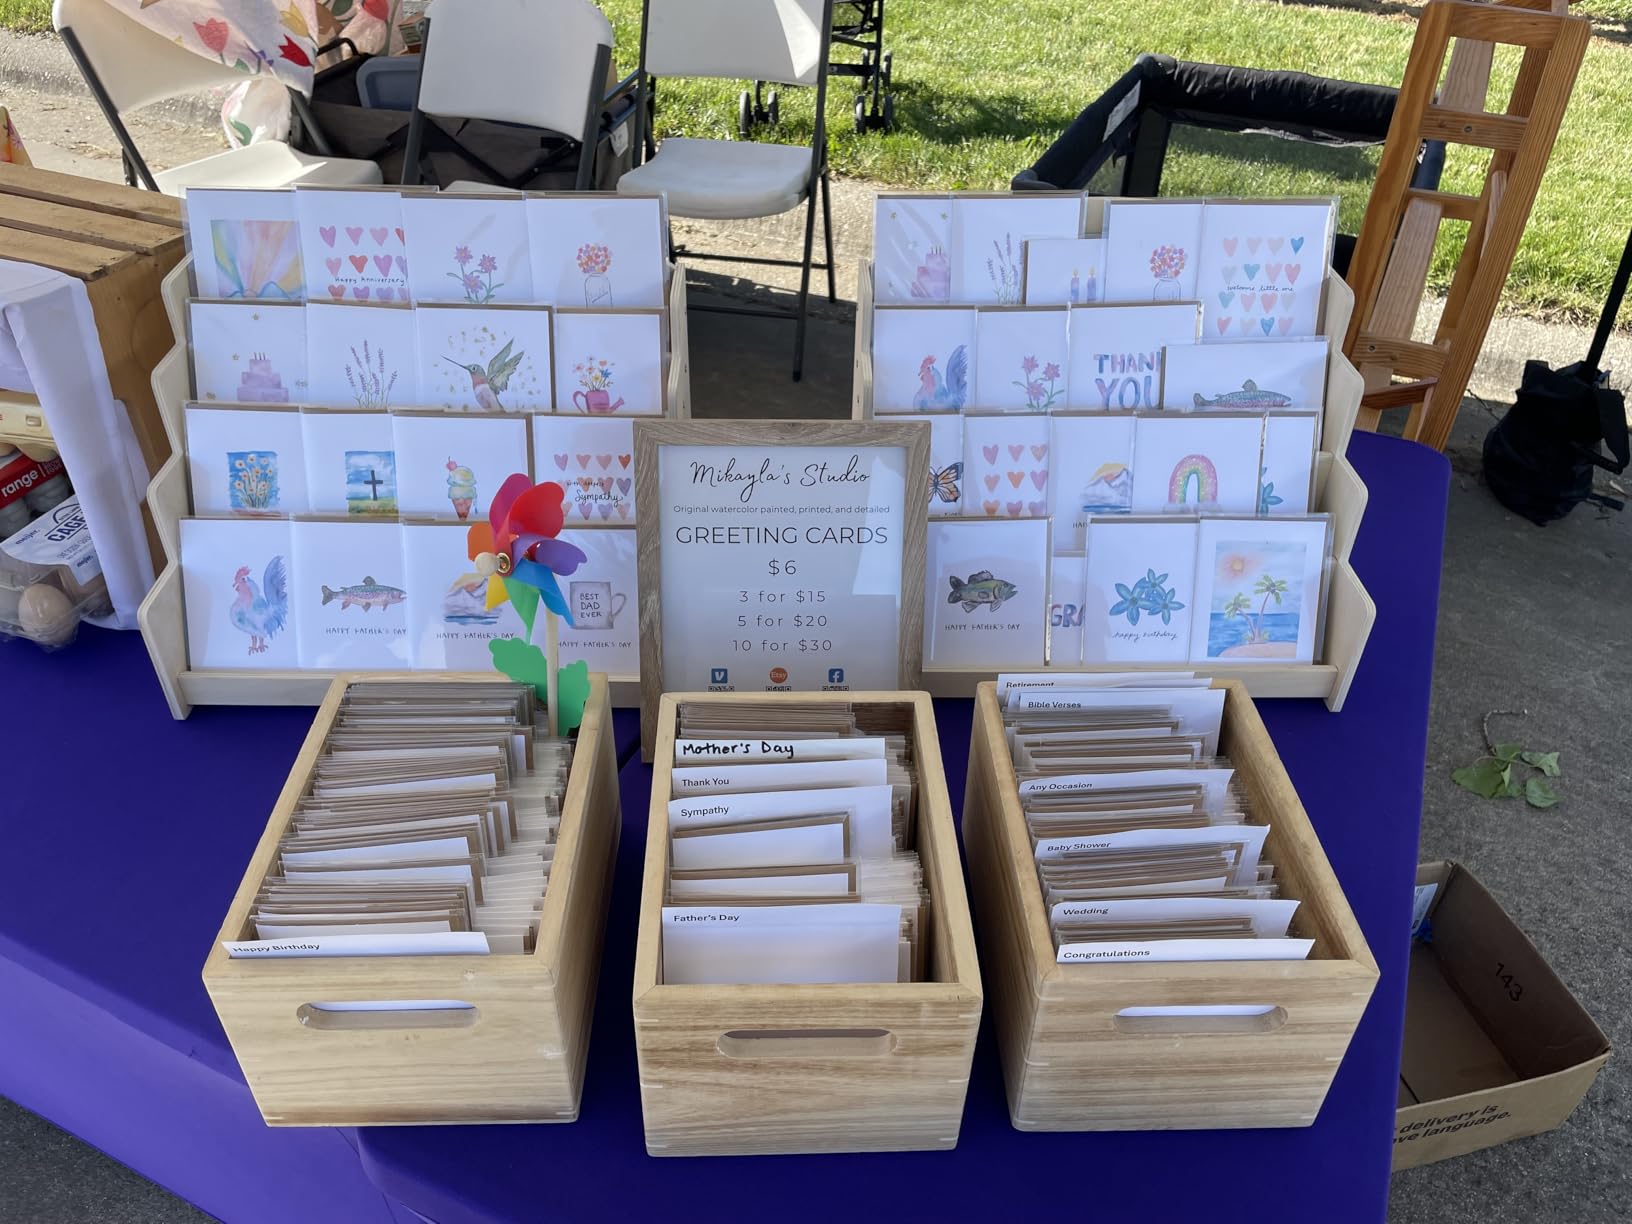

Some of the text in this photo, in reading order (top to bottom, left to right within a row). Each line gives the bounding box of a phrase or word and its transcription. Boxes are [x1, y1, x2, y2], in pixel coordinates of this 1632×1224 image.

[1, 470, 39, 497] range
[690, 454, 870, 503] Mikayla's Studio
[575, 489, 623, 508] Sympathy
[673, 505, 890, 515] Original watercolor painted, printed, and detailed
[675, 526, 888, 545] GREETING CARDS
[768, 557, 797, 576] $6
[580, 592, 599, 601] BEST
[739, 589, 826, 603] 3 for $15
[580, 601, 600, 610] DAD
[737, 613, 827, 628] 5 for $20
[732, 638, 832, 652] 10 for $30
[1028, 701, 1082, 709] Bible Verses
[682, 740, 794, 759] Mother's Day
[681, 777, 730, 787] Thank You
[1049, 782, 1093, 790] Occasion
[680, 805, 730, 818] Sympathy
[1073, 842, 1112, 850] Shower
[674, 914, 740, 922] Father's Day
[1063, 950, 1151, 959] Congratulations
[1495, 961, 1522, 1002] 143
[1400, 1105, 1499, 1133] delivery is
[1393, 1111, 1512, 1144] ve language.
